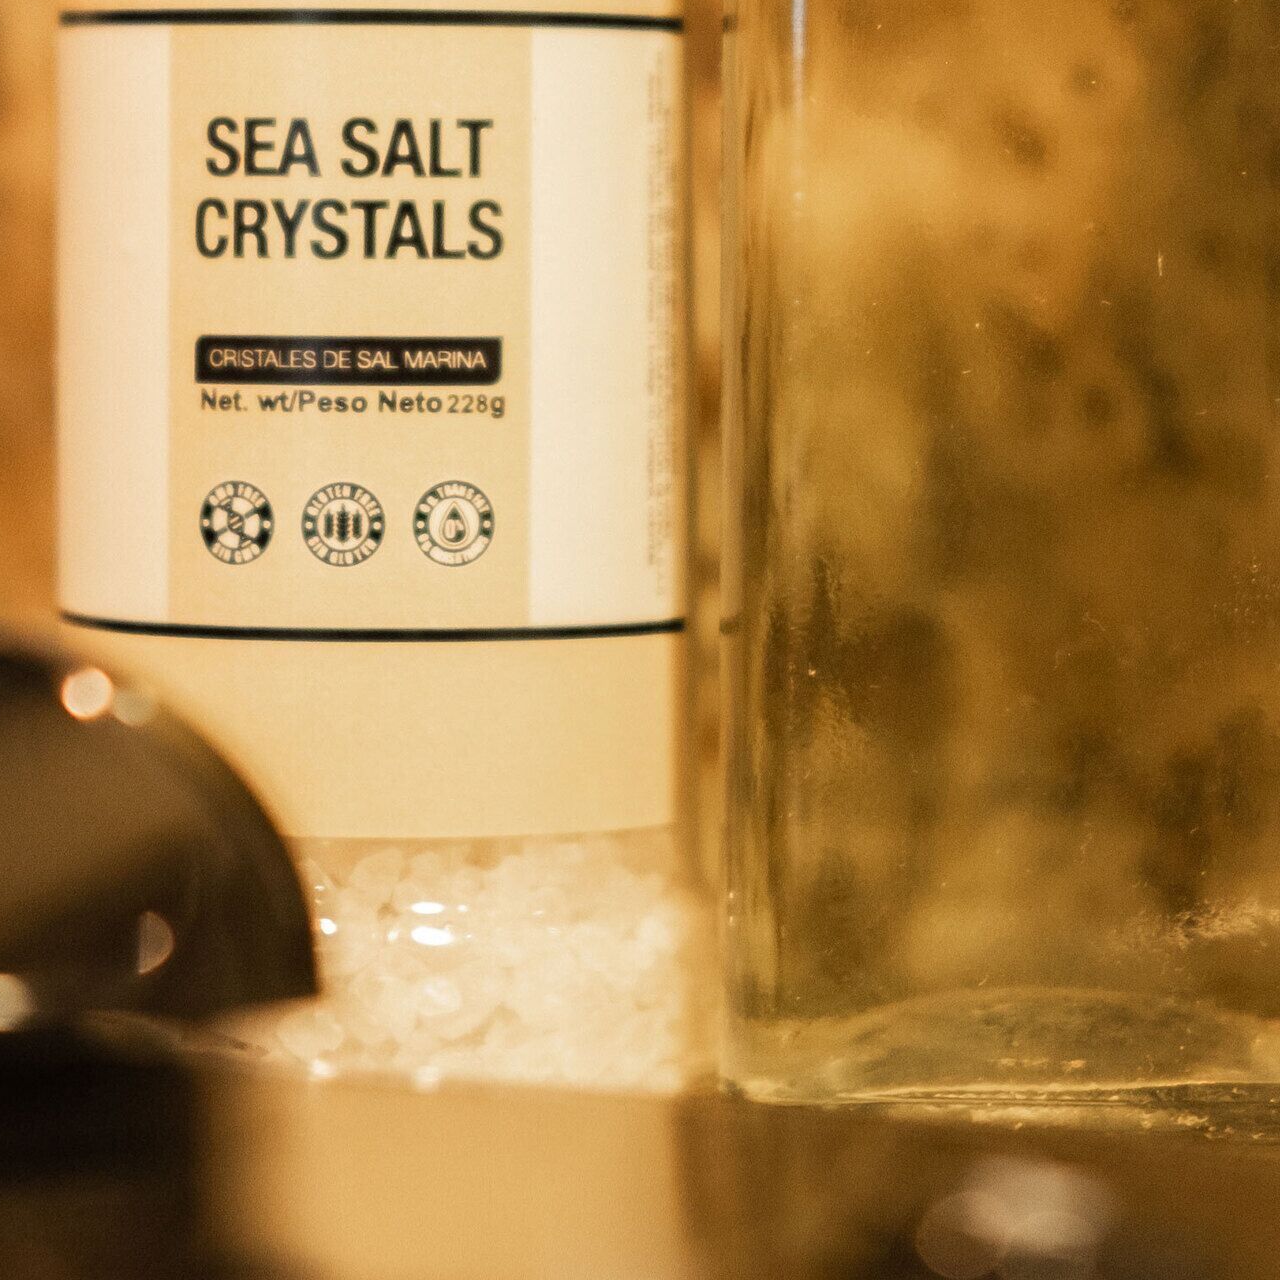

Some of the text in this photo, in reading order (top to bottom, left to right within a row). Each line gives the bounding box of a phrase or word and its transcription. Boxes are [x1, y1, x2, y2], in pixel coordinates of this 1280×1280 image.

[205, 114, 494, 179] SEA SALT
[194, 197, 505, 260] CRYSTALS
[209, 348, 487, 370] CRISTALES DE SAL MARINA
[200, 388, 506, 419] Net. wt/Peso Neto 228g
